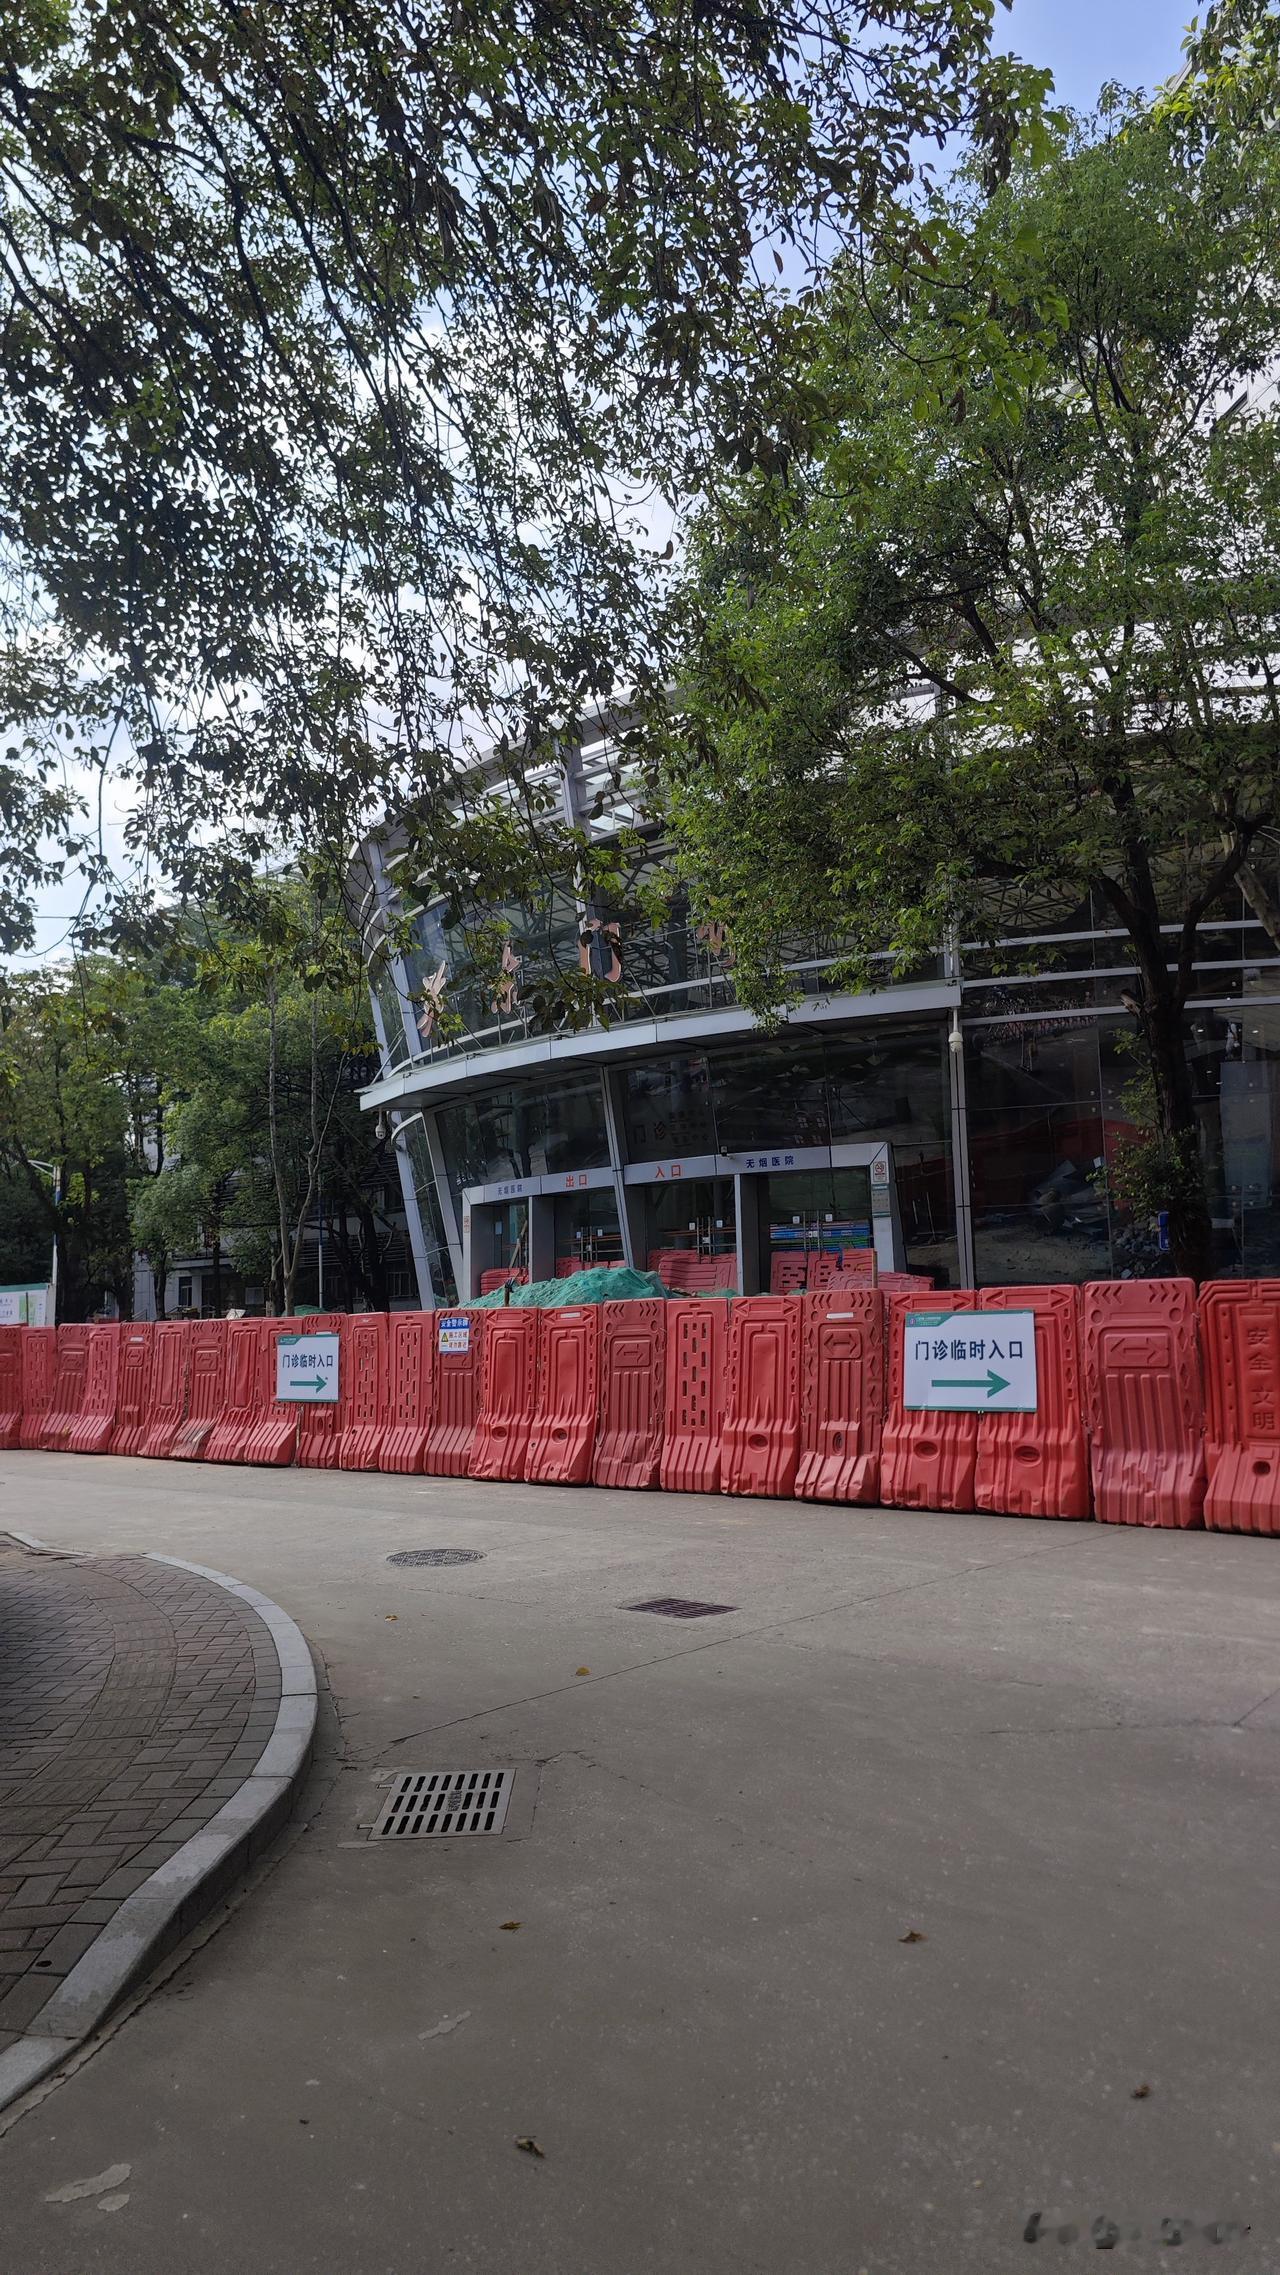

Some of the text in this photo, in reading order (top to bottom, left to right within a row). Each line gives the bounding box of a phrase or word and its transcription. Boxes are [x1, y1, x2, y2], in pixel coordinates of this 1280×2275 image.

[746, 1155, 794, 1168] 无烟医院
[656, 1164, 681, 1178] 入口
[566, 1174, 587, 1187] 出口
[915, 1339, 1023, 1361] 门诊临时入口
[282, 1353, 333, 1369] 门诊临时入口
[1247, 1326, 1275, 1430] 安全文明
